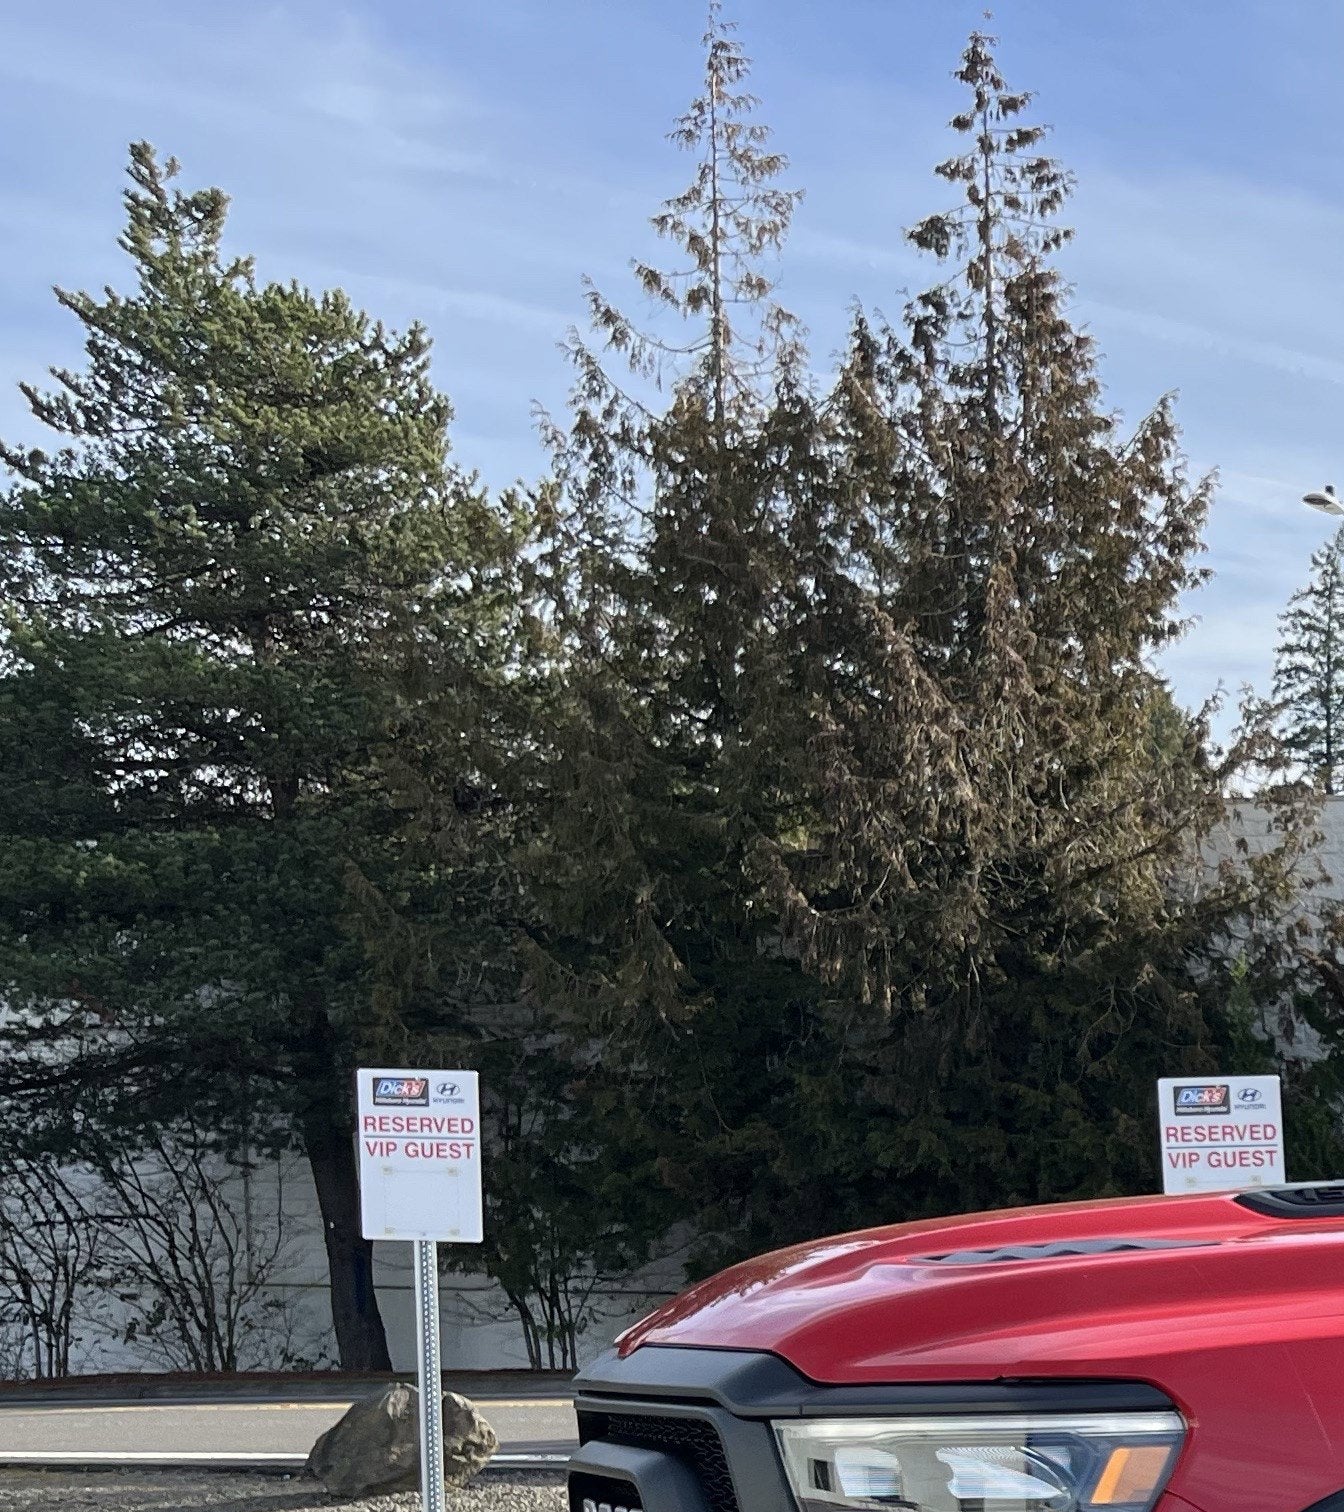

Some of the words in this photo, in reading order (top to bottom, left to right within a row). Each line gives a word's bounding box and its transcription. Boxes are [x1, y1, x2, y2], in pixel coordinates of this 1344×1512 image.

[364, 1116, 474, 1134] RESERVED
[1166, 1124, 1277, 1142] RESERVED
[366, 1141, 398, 1157] VIP
[404, 1142, 475, 1159] GUEST
[1168, 1152, 1200, 1169] VIP
[1207, 1150, 1277, 1168] GUEST
